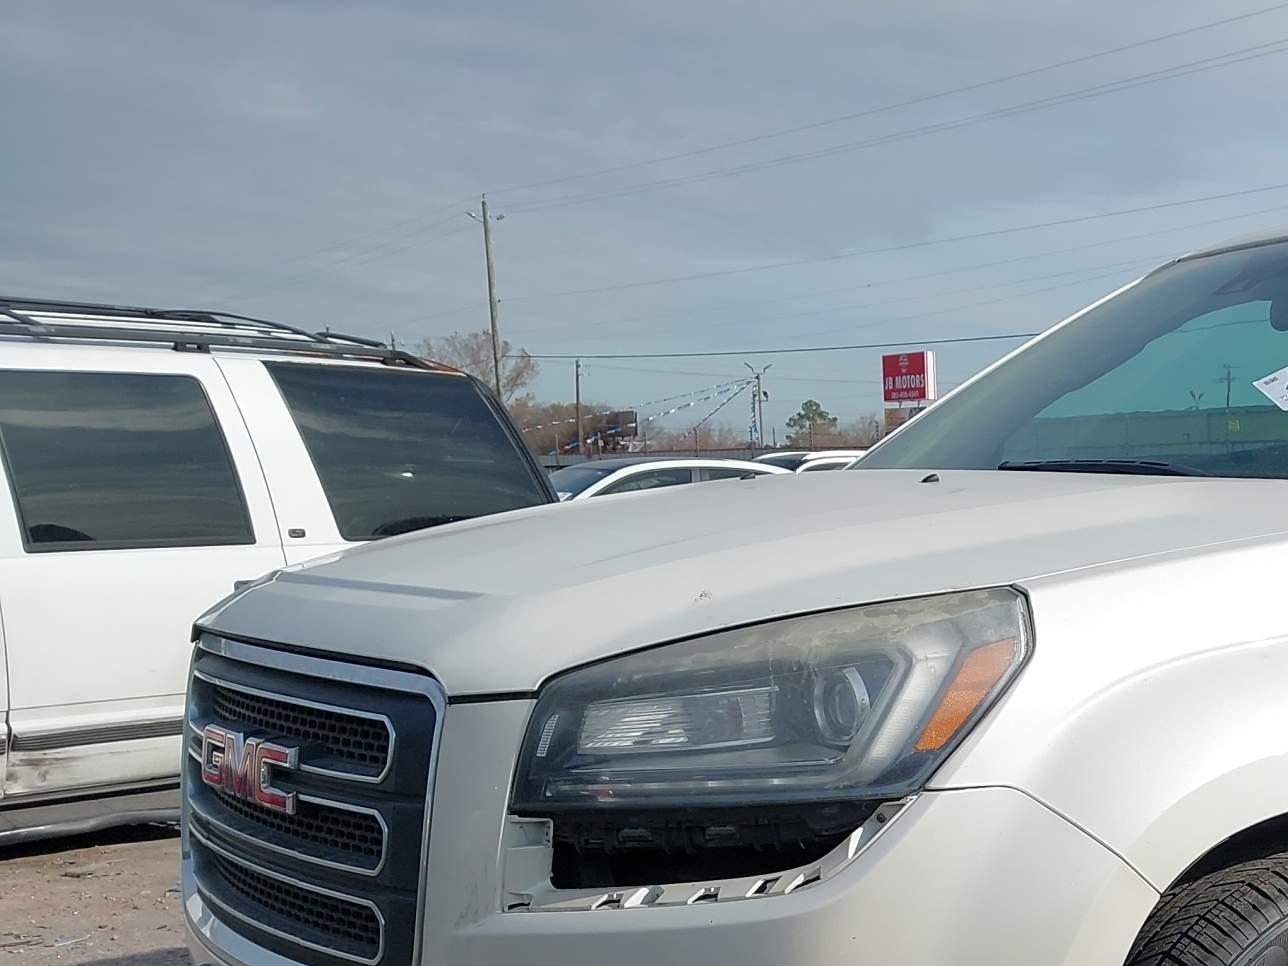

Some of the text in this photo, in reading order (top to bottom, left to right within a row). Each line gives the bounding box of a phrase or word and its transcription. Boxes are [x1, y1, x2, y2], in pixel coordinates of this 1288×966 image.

[885, 374, 925, 390] JB MOTORS
[201, 723, 300, 816] GMC
